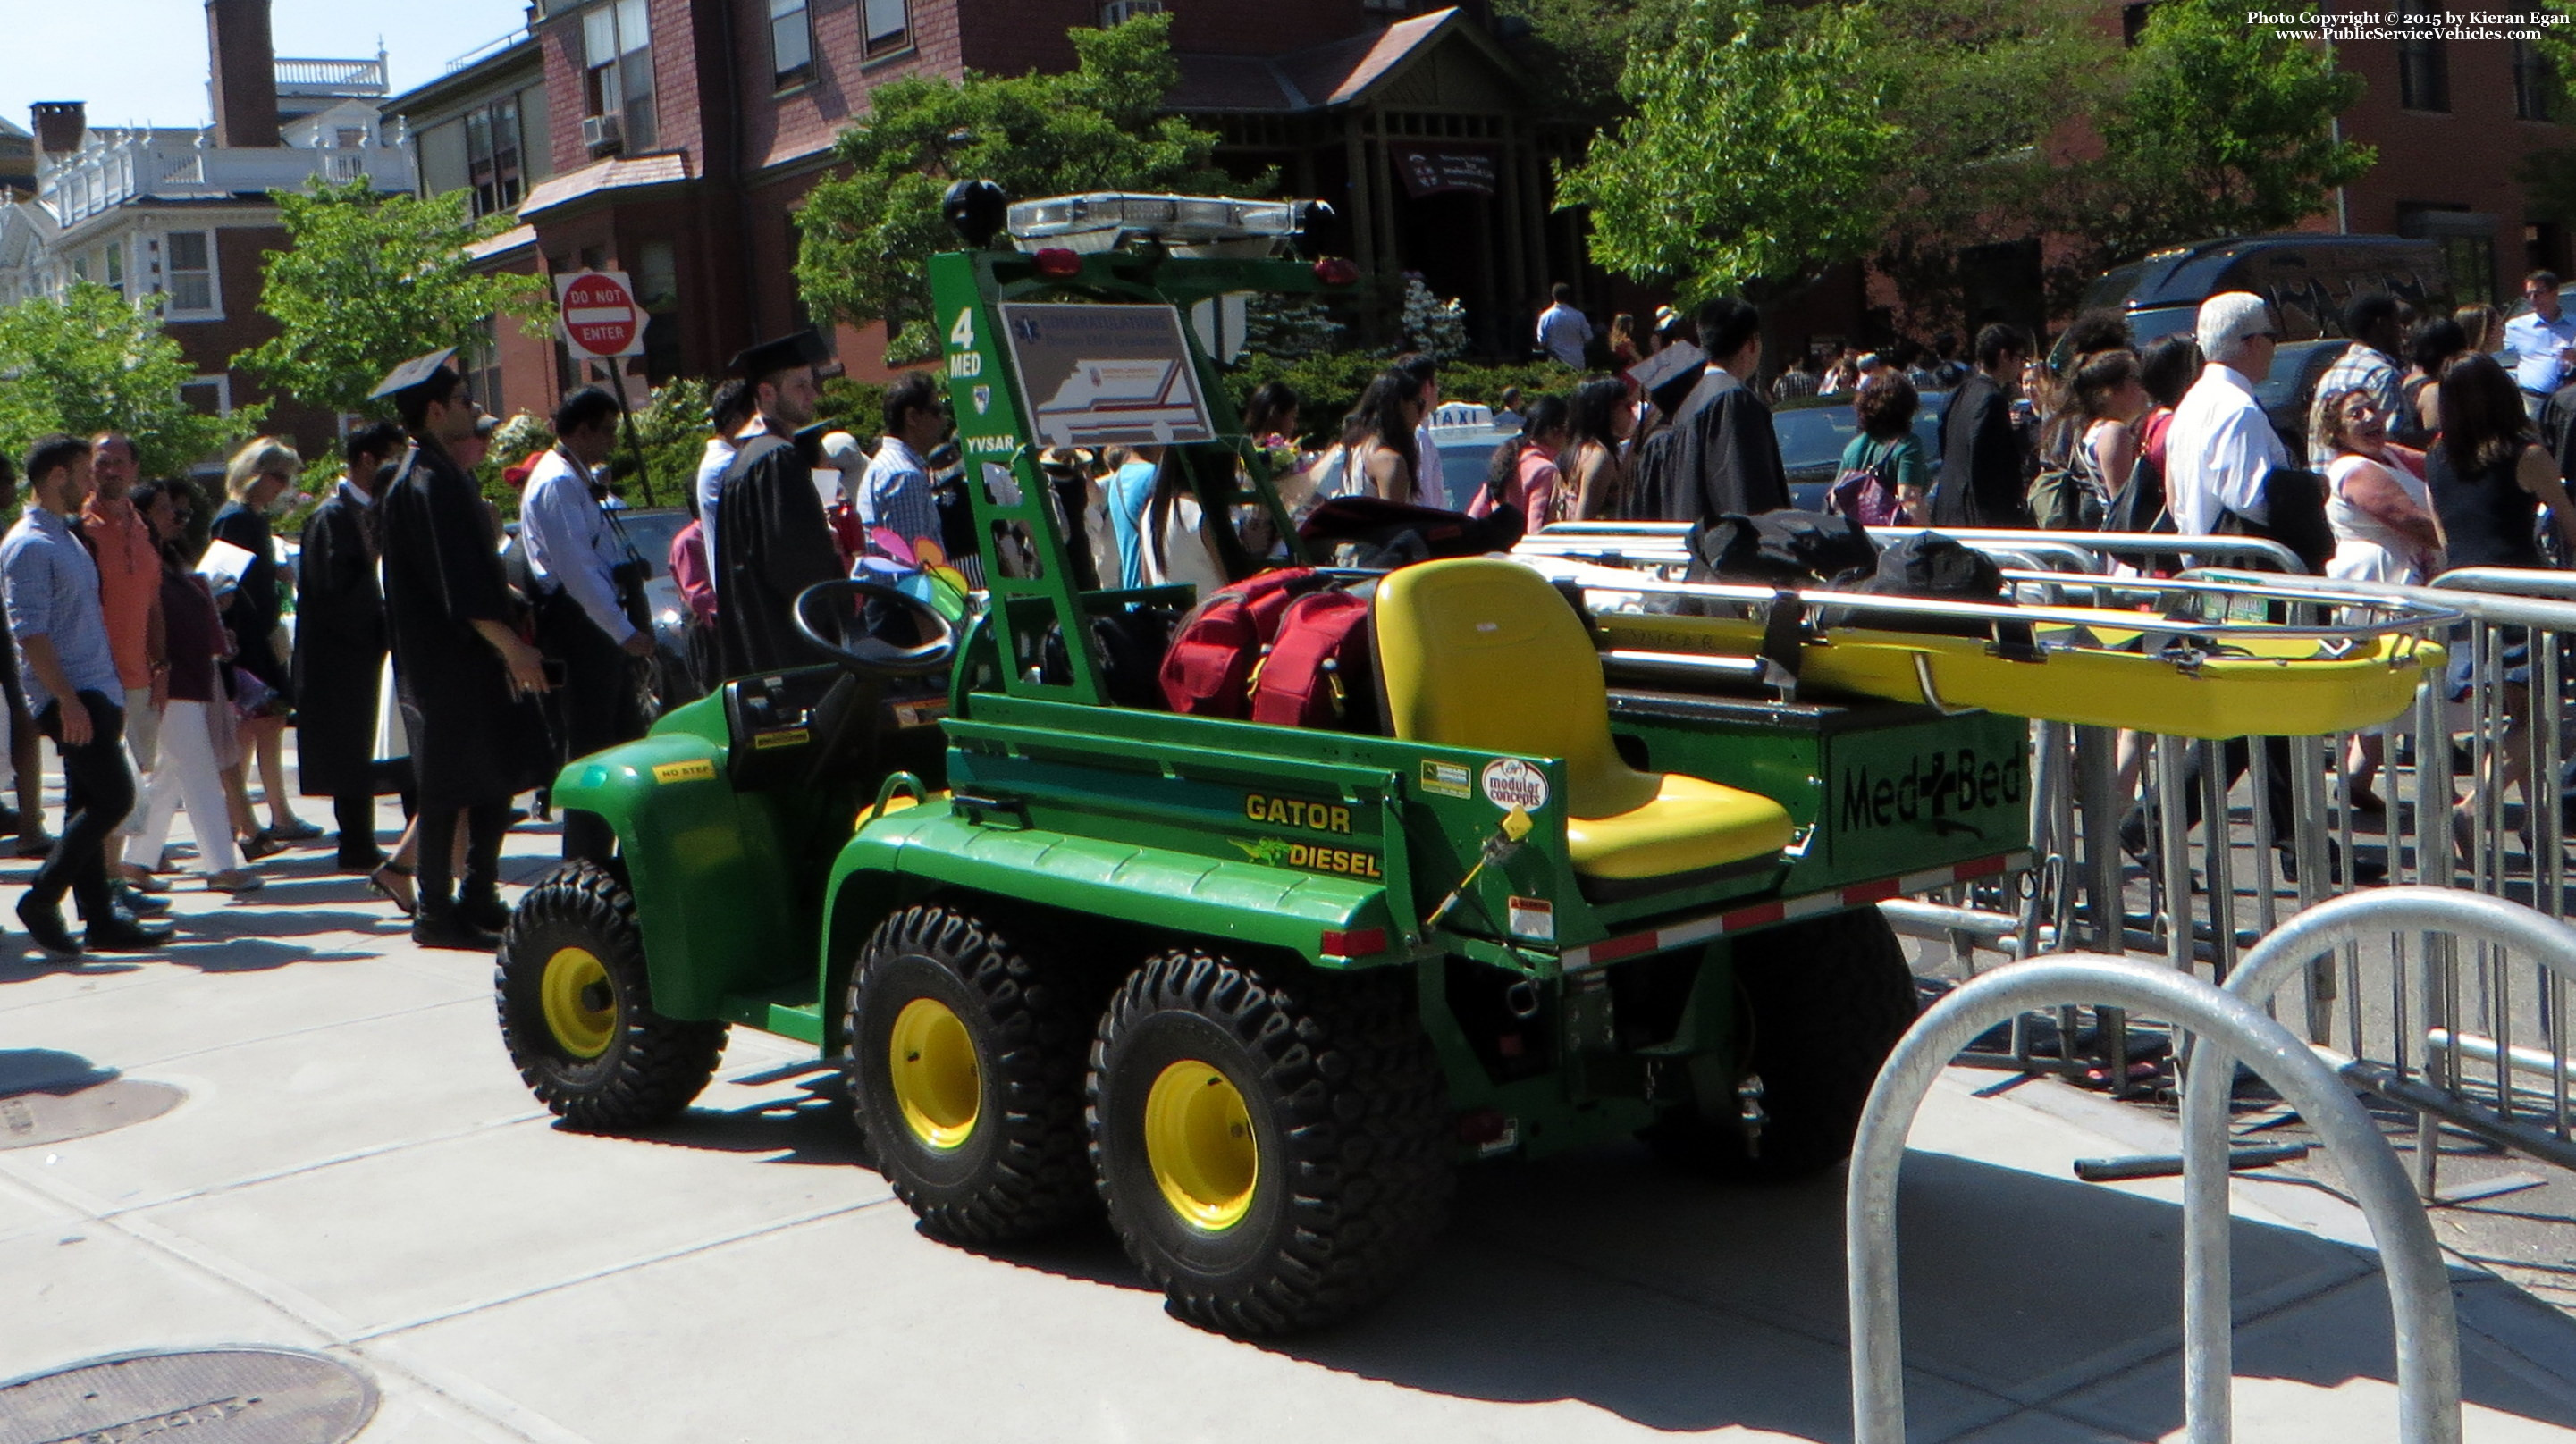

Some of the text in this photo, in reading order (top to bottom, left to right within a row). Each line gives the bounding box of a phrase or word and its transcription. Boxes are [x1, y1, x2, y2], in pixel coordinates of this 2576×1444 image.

[570, 289, 621, 304] DO NOT
[583, 326, 624, 340] ENTER
[950, 306, 974, 350] 4
[950, 352, 981, 379] MED
[1431, 408, 1477, 426] TAXI
[966, 434, 1014, 454] YVSAR
[661, 768, 679, 777] NO
[1489, 777, 1541, 794] modular
[1841, 740, 2021, 833] Med Bed
[1490, 789, 1541, 806] concepts
[1246, 793, 1351, 834] GATOR
[1289, 843, 1383, 878] DIESEL
